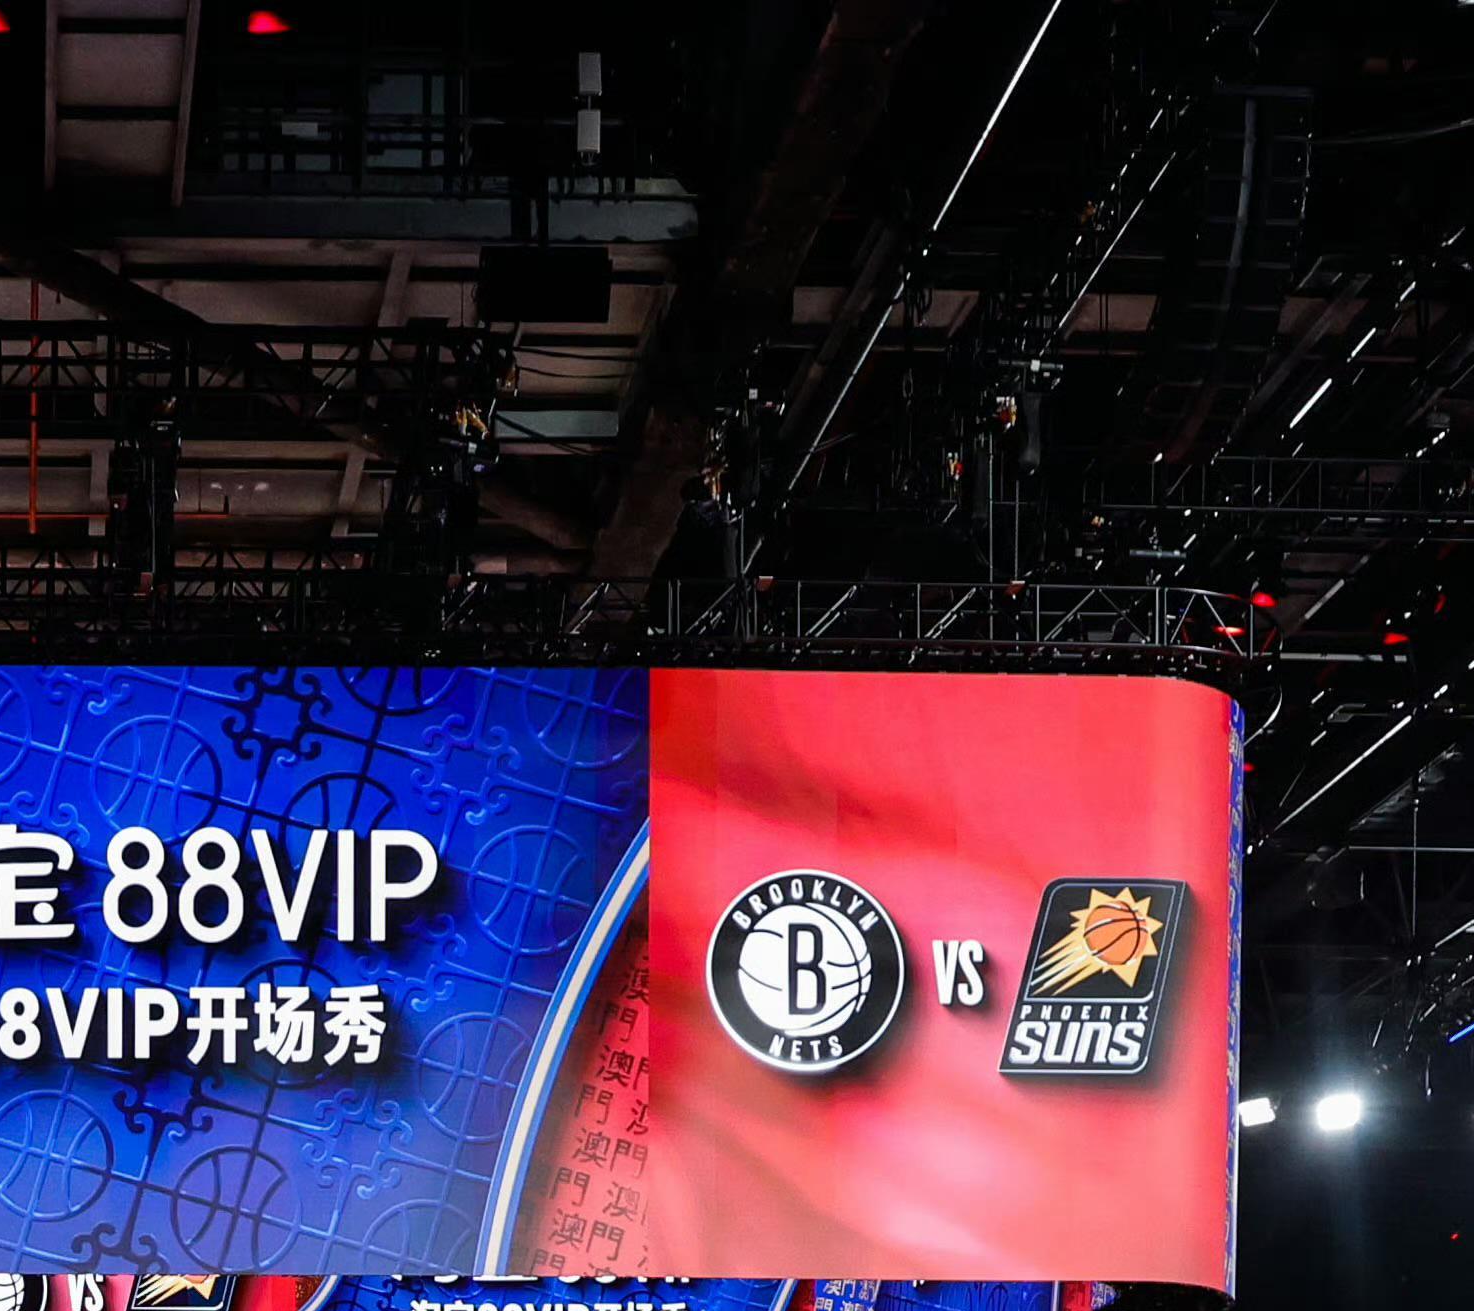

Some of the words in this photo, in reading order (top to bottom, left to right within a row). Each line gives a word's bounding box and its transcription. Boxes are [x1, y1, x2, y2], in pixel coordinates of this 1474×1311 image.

[732, 878, 879, 931] BROOKLYN
[932, 939, 984, 1006] VS
[1019, 1005, 1149, 1021] PHOENIX
[769, 1034, 844, 1062] NETS
[1009, 1021, 1145, 1064] SUNS
